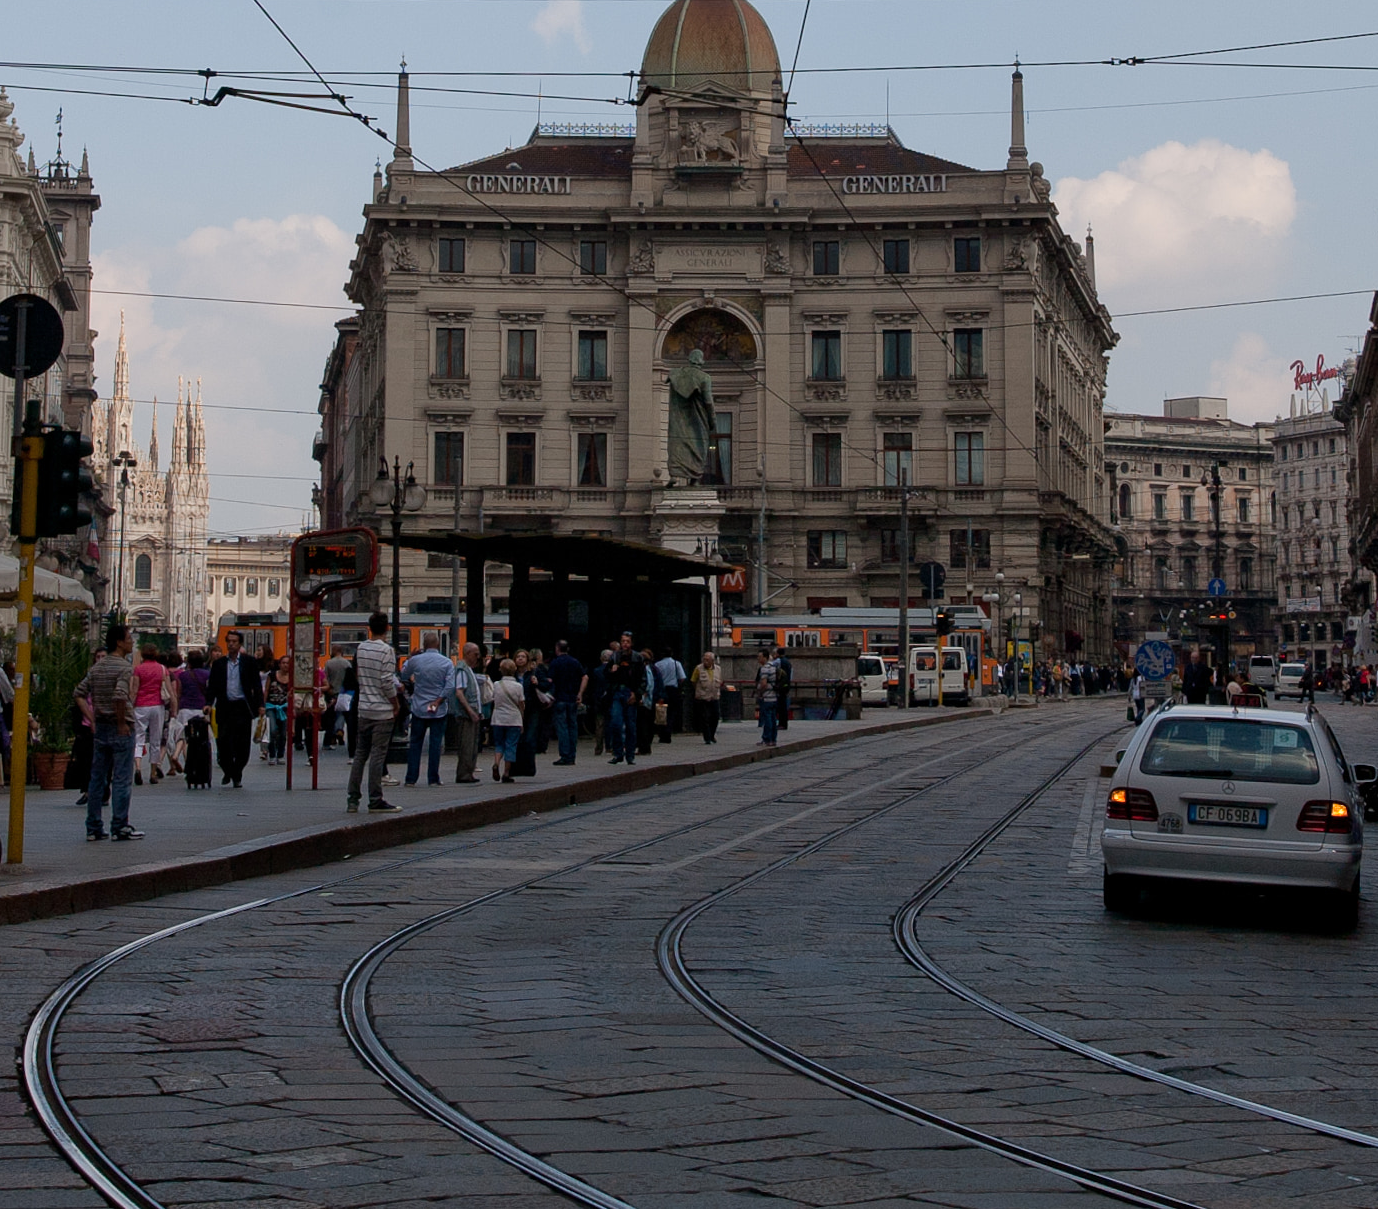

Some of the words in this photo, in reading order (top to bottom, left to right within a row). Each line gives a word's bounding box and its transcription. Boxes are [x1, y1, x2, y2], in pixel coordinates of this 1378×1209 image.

[466, 174, 572, 194] GENERALI
[842, 173, 947, 194] GENERALI
[687, 258, 733, 267] GENERALI
